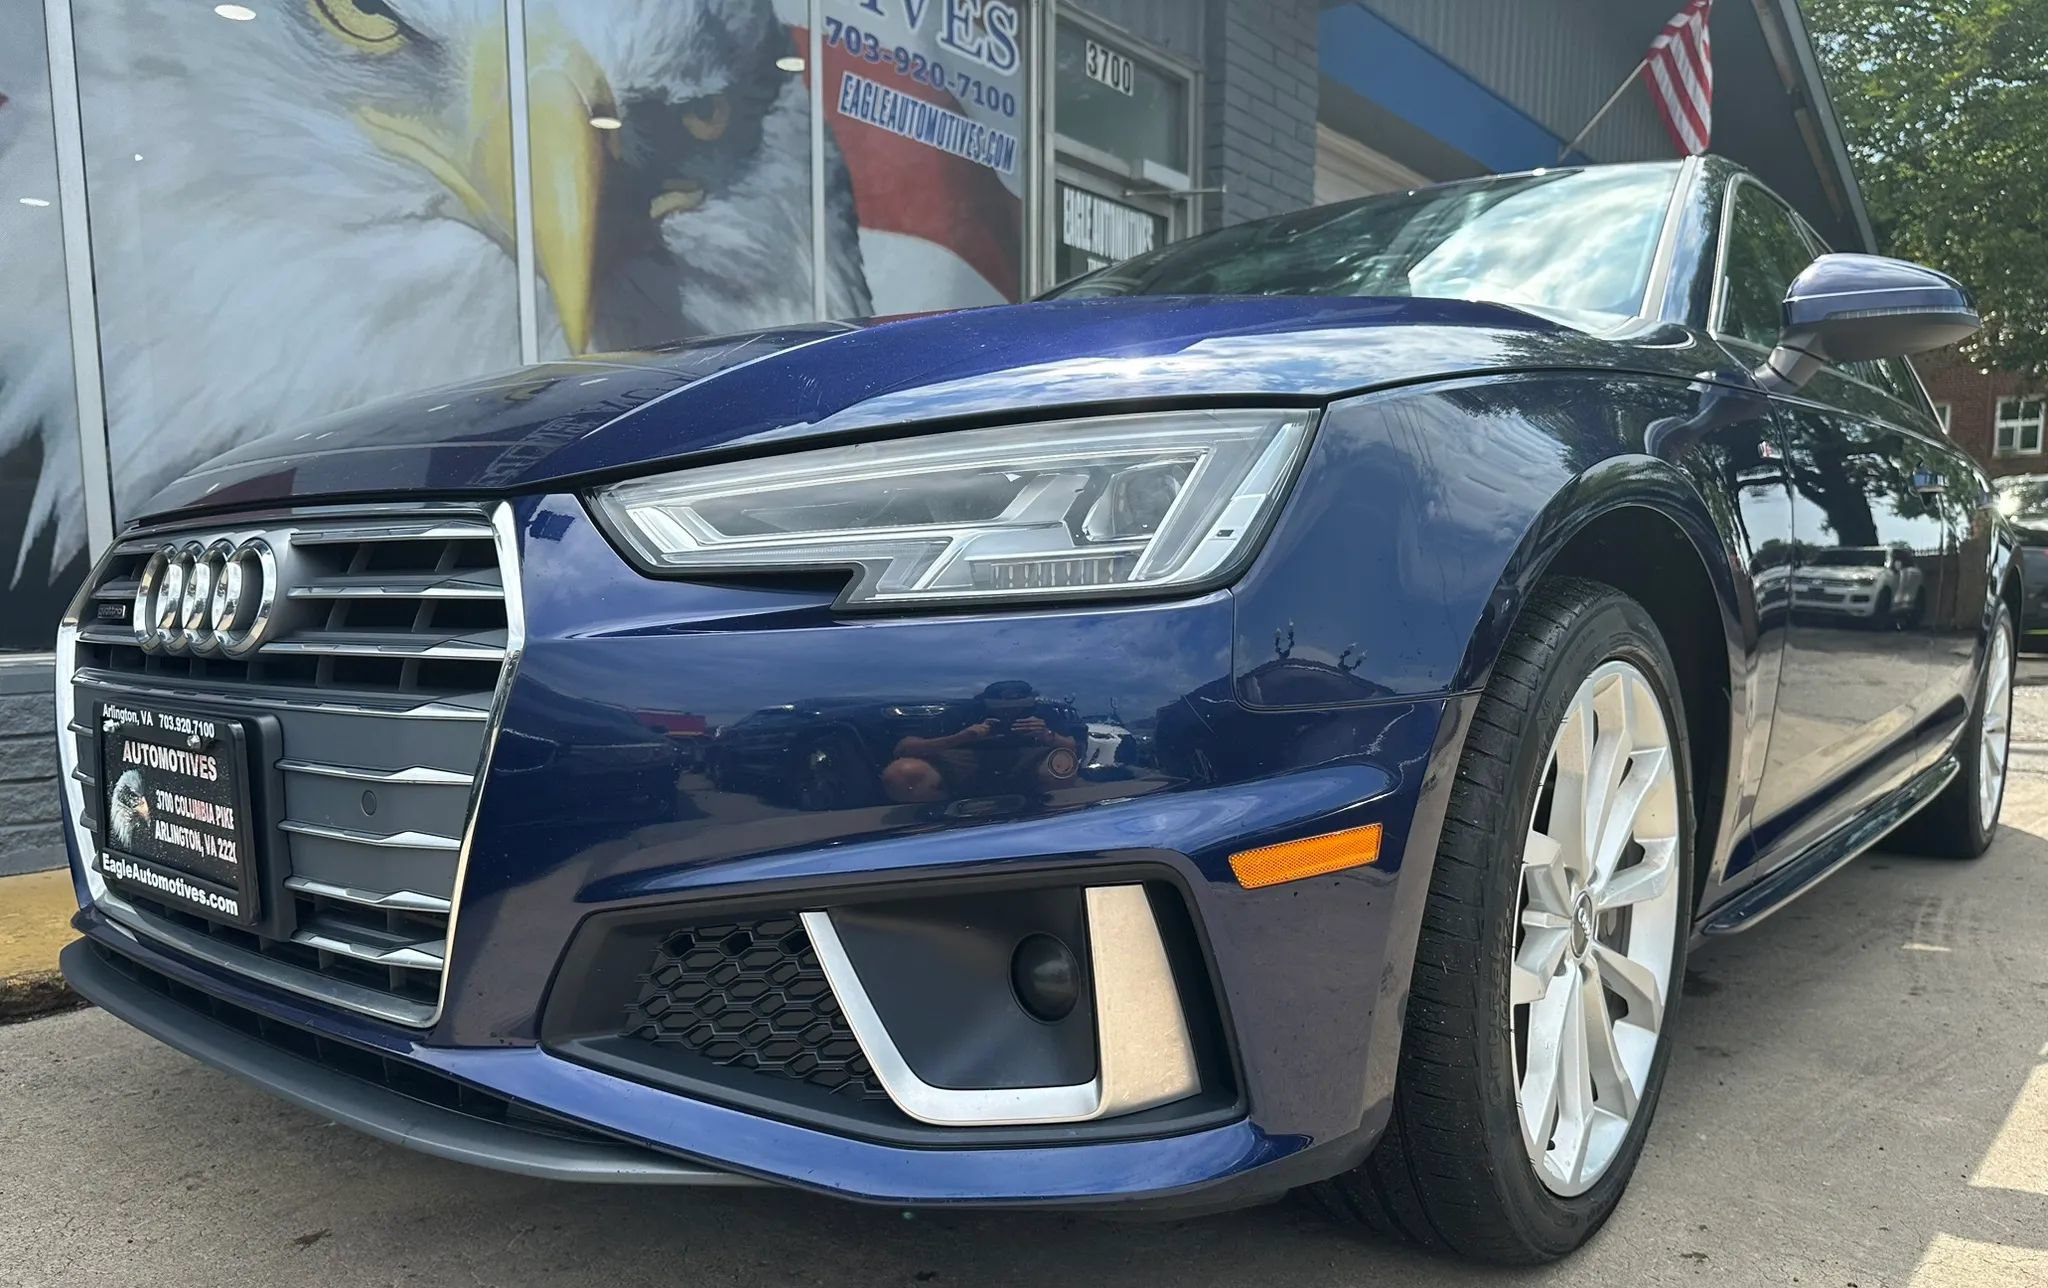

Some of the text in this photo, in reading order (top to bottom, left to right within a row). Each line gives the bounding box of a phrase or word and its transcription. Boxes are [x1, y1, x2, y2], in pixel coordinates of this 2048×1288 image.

[825, 16, 1015, 118] 703-920-7100
[1088, 43, 1131, 94] 3700
[840, 73, 1015, 172] EAGLEAUTOMOTIVES.COM
[103, 704, 215, 738] Arlington, VA 703.920.7100
[122, 740, 217, 782] AUTOMOTIVES
[155, 789, 235, 830] 3700 COLUMBIA PIKE
[155, 820, 204, 857] ARLINGTON,
[203, 833, 217, 857] VA
[102, 852, 239, 917] EagleAutomotives.com
